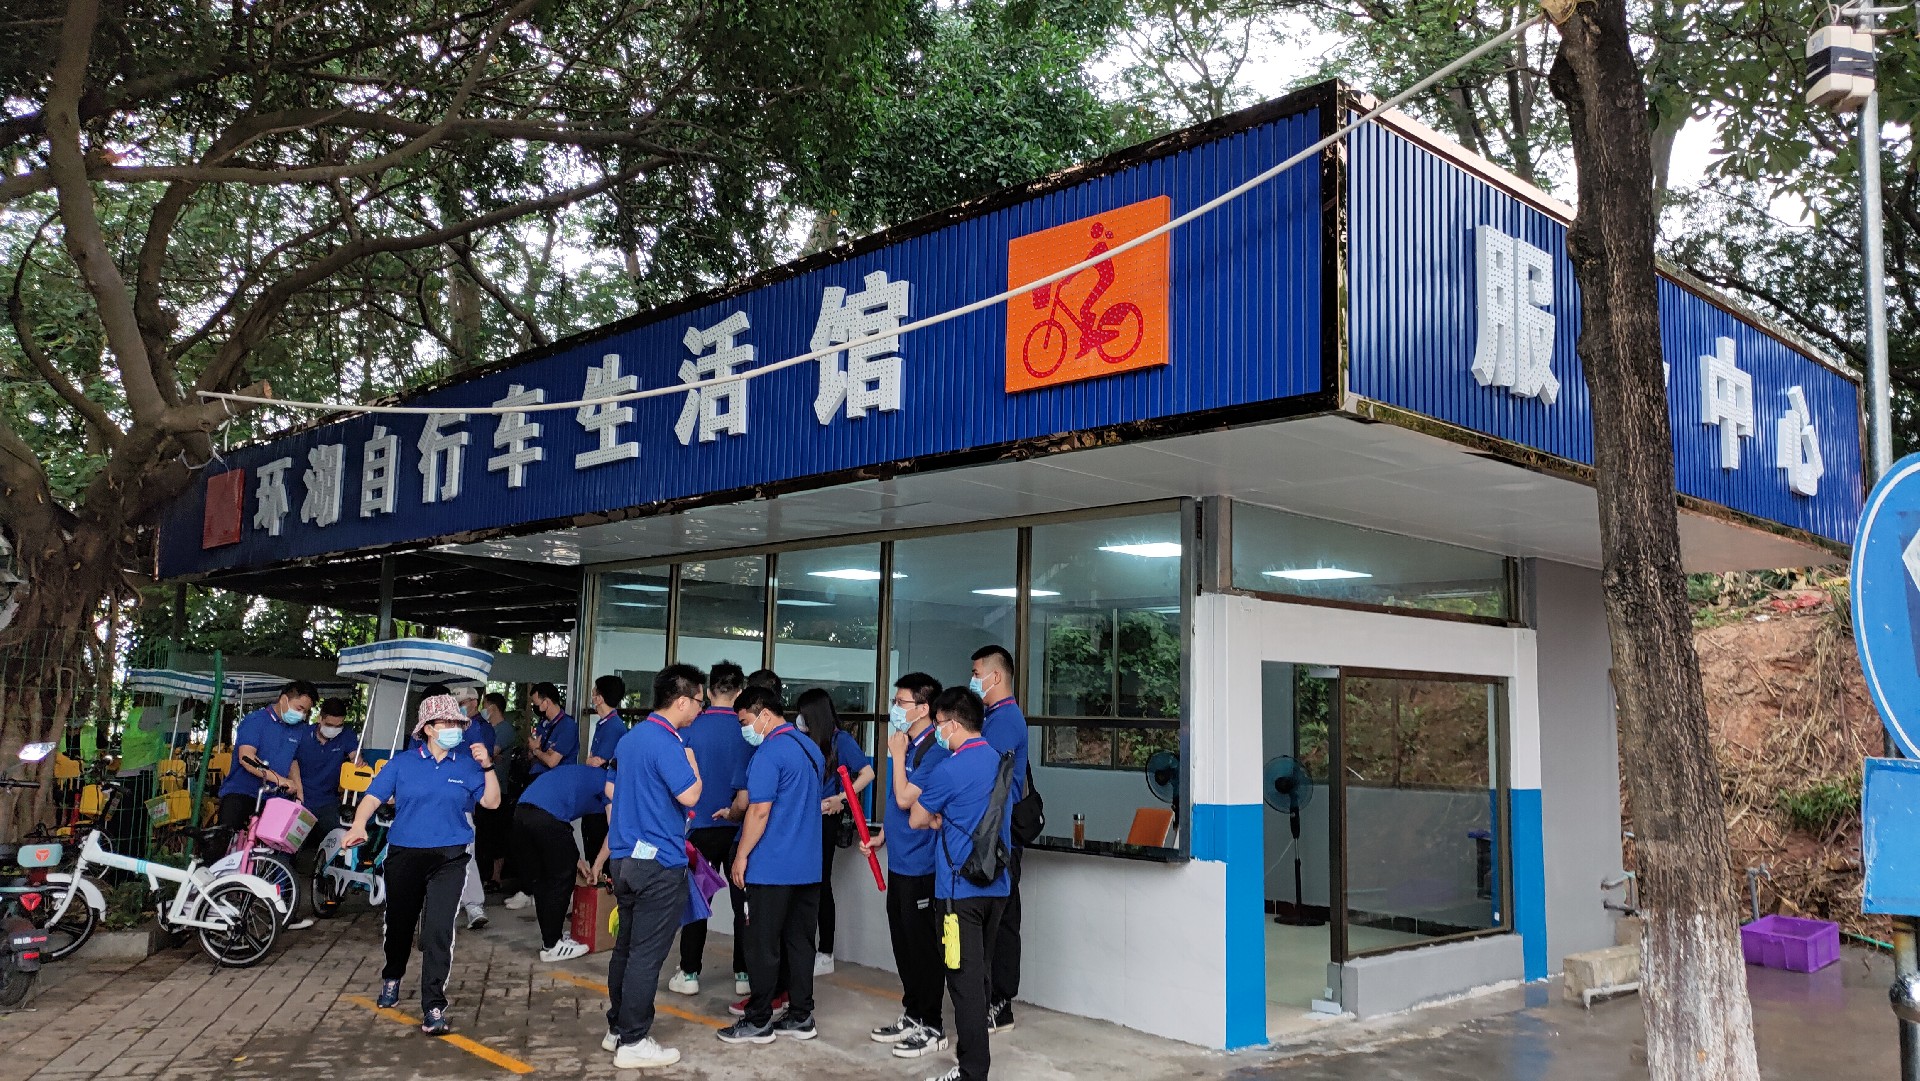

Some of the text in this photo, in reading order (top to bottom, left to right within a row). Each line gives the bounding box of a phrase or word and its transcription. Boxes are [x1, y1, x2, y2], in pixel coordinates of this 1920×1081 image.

[253, 270, 909, 536] 环湖自行车生活馆
[1472, 224, 1824, 497] 服中心
